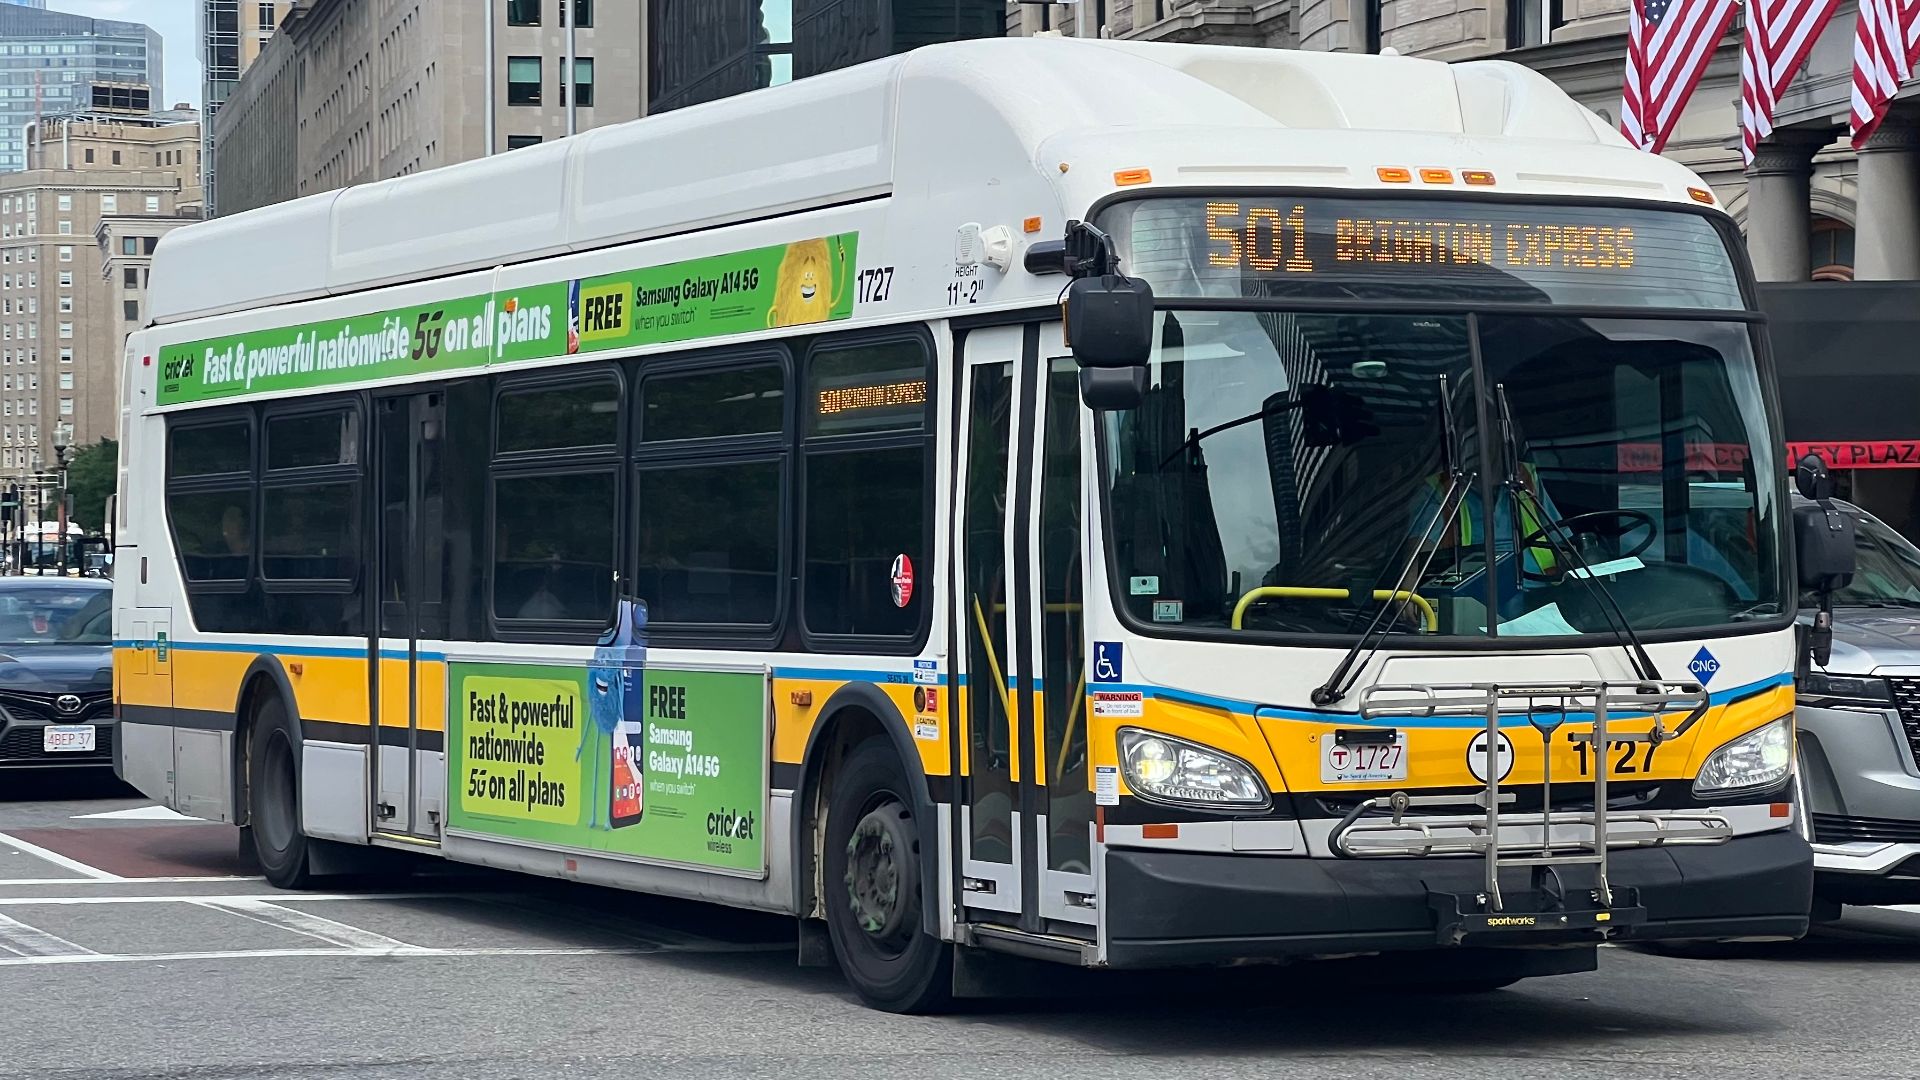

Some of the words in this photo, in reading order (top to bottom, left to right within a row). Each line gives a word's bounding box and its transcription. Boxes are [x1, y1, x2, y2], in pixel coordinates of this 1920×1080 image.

[1206, 203, 1313, 271] 501
[1336, 219, 1492, 264] BRIGHTON
[1507, 223, 1635, 268] EXPRESS
[857, 266, 894, 303] 1727
[955, 265, 978, 277] HEIGHT
[636, 286, 680, 307] Samsung
[683, 276, 719, 302] Galaxy
[720, 270, 741, 294] A14
[742, 267, 759, 291] 5G
[584, 293, 623, 332] FREE
[635, 314, 655, 330] when
[656, 314, 670, 331] you
[203, 346, 232, 384] Fast
[234, 342, 246, 380] &
[246, 330, 316, 389] powerful
[317, 316, 409, 371] nationwide
[412, 310, 443, 360] 5G
[444, 318, 467, 352] on
[471, 300, 495, 349] all
[497, 297, 551, 357] plans
[164, 353, 195, 380] cricket
[1851, 444, 1920, 464] PLAZ
[1691, 660, 1717, 672] CNG
[650, 685, 686, 719] FREE
[1098, 693, 1139, 701] WARNING
[470, 691, 496, 723] Fast
[499, 692, 509, 724] &
[511, 694, 573, 733] powerful
[919, 718, 937, 726] CAUTION
[78, 733, 91, 745] 37
[469, 727, 545, 765] nationwide
[649, 723, 692, 752] Samsung
[649, 751, 683, 779] Galaxy
[684, 754, 703, 776] A14
[704, 756, 720, 777] 5G
[1333, 751, 1348, 765] T
[1355, 745, 1402, 770] 1727
[1572, 740, 1658, 775] 127
[468, 768, 487, 797] 5G
[489, 776, 505, 800] on
[509, 769, 524, 802] all
[528, 772, 564, 812] plans
[707, 807, 755, 840] cricket
[707, 839, 732, 854] wireless
[1487, 917, 1535, 926] sportworks
